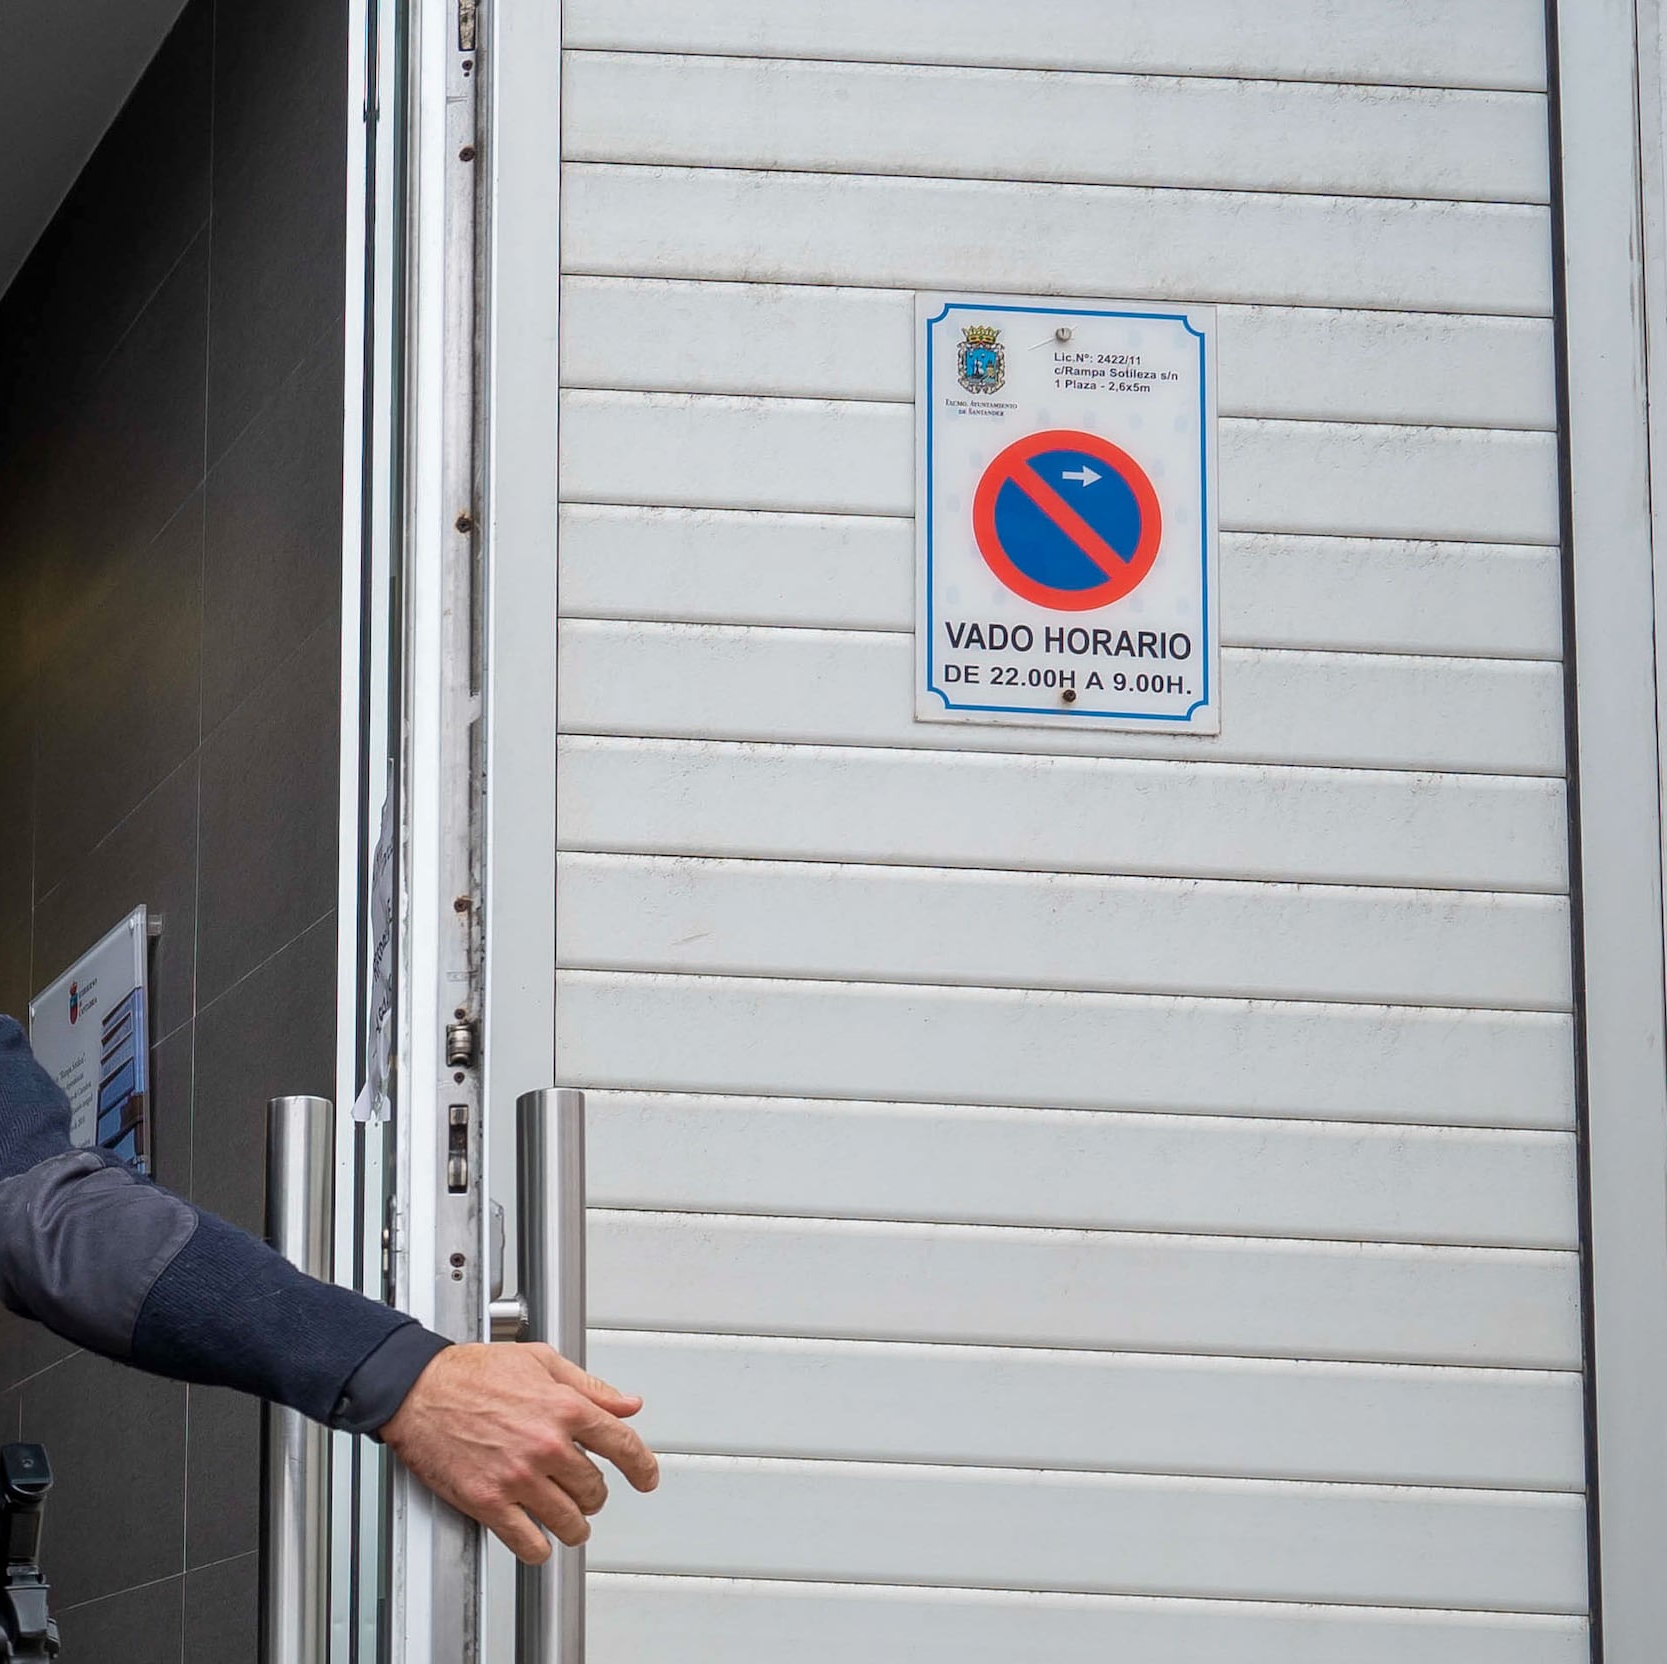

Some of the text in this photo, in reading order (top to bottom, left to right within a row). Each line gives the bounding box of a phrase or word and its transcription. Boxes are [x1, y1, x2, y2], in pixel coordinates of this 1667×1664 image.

[1097, 354, 1142, 366] 2422/11
[1053, 366, 1179, 382] c/Rampa Sotileza s/n
[1054, 379, 1061, 389] 1
[1065, 380, 1097, 391] Plaza
[1108, 381, 1151, 394] 2,6x5m
[944, 621, 1192, 660] VADO HORARIO
[944, 664, 1192, 695] DE 22.00H A 9.00H.
